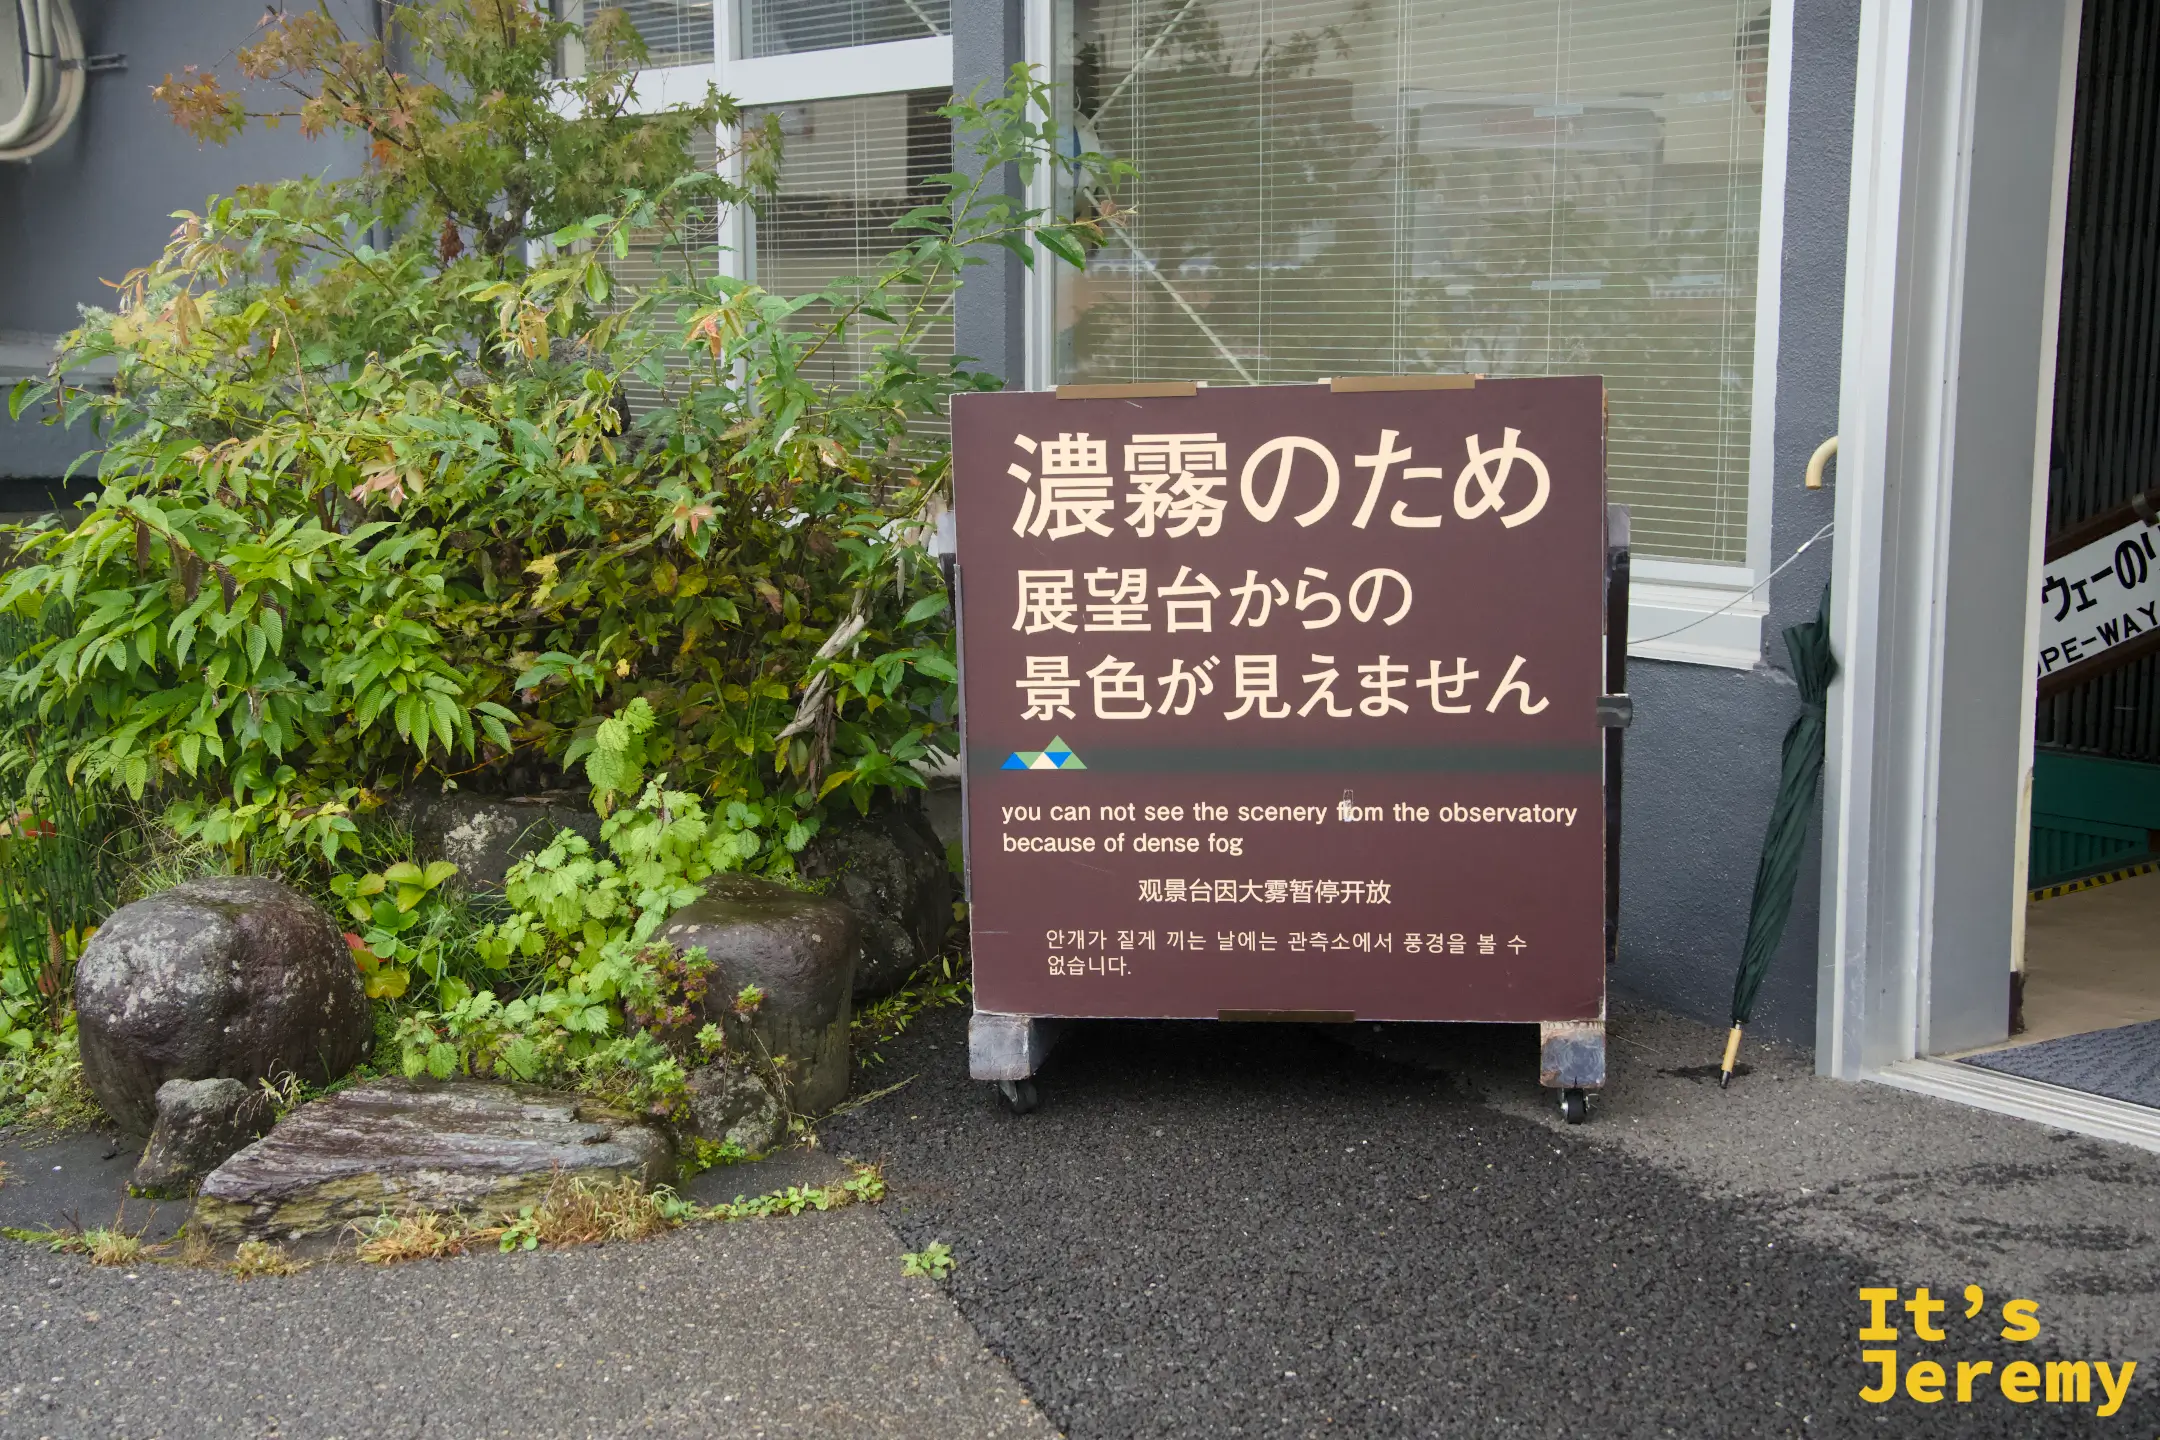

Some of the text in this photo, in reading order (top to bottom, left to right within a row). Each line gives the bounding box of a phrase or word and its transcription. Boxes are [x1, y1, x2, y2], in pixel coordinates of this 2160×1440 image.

[1007, 427, 1550, 541] 濃霧のため
[1012, 565, 1413, 635] 展望台からの
[2037, 600, 2158, 678] PE-WAY
[1016, 654, 1550, 721] 景色が見えません
[1001, 805, 1041, 825] you
[1050, 805, 1091, 822] can
[1100, 802, 1136, 822] not
[1144, 805, 1185, 822] see
[1193, 802, 1229, 822] the
[1237, 805, 1328, 825] scenery
[1393, 802, 1430, 823] the
[1439, 802, 1578, 826] observatory
[1002, 832, 1244, 857] because of dense fog
[1138, 878, 1392, 905] 观景台因大雾暂停开放
[1046, 929, 1527, 955] 안개가 짙게 끼는 날에는 관측소에서 풍경을 볼 수
[1047, 955, 1132, 977] 없습니다.
